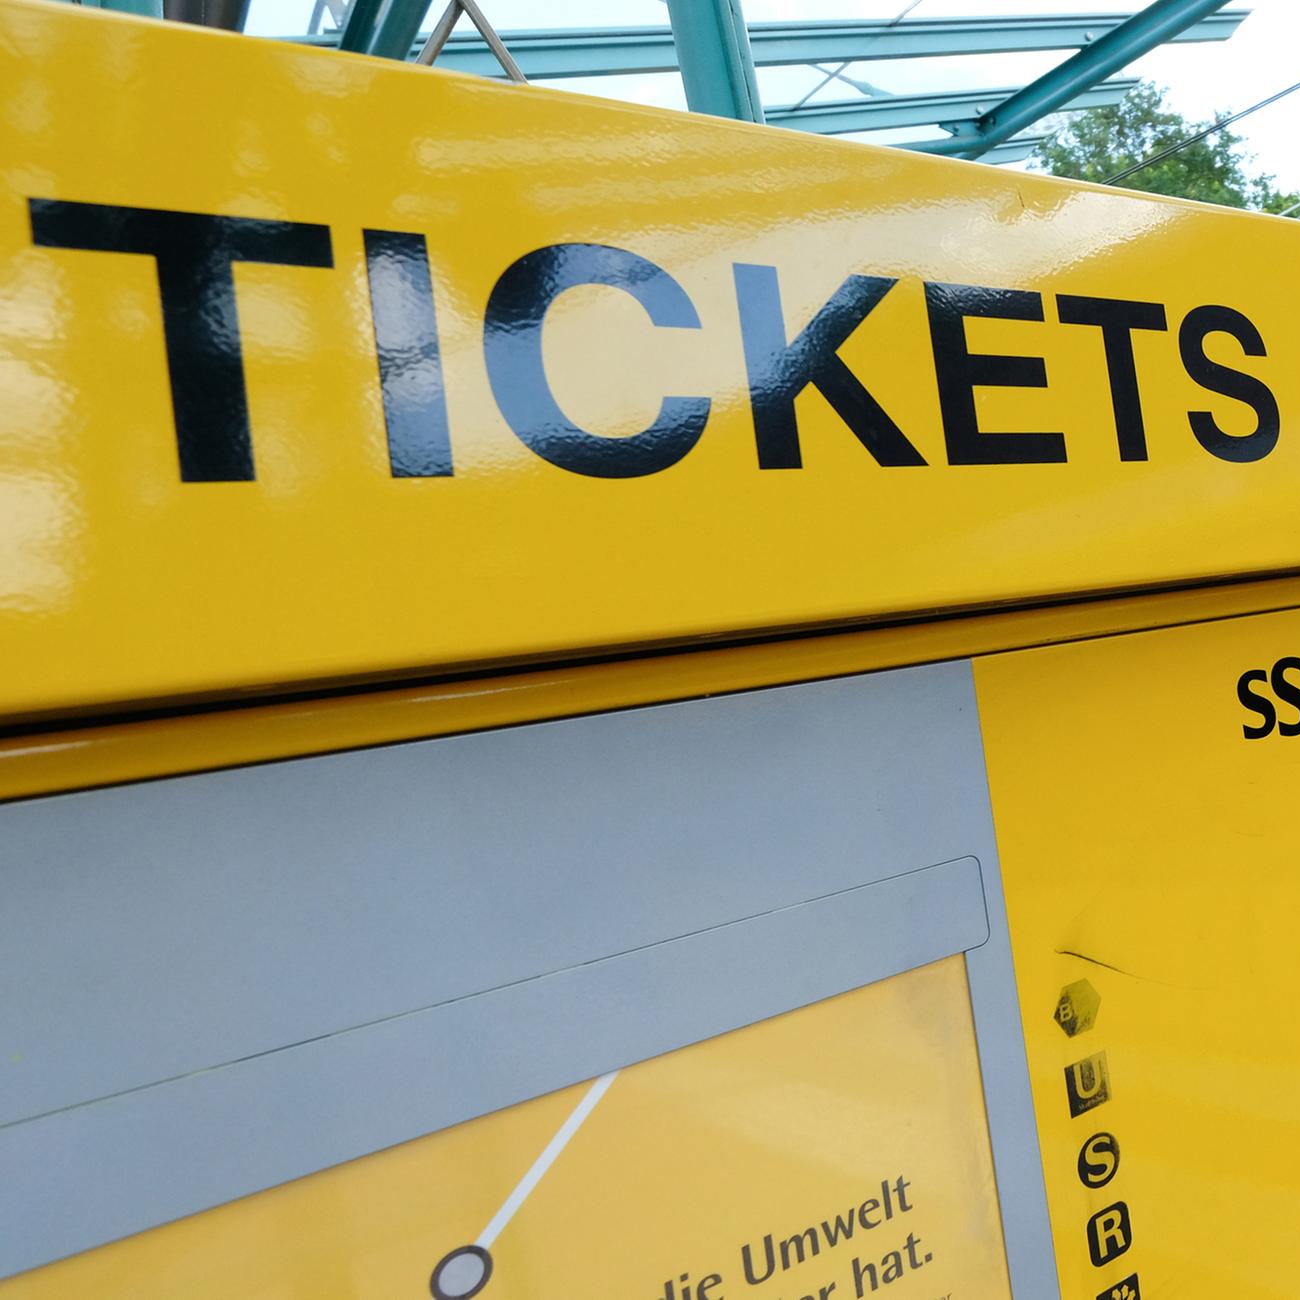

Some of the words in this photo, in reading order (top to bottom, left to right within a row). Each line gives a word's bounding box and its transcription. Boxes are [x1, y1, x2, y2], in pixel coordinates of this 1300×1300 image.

[27, 197, 1280, 483] TICKETS
[1073, 1056, 1102, 1099] U
[1085, 1136, 1115, 1183] S
[741, 1175, 913, 1286] Umwelt
[1095, 1209, 1126, 1259] R
[852, 1232, 933, 1299] hat.
